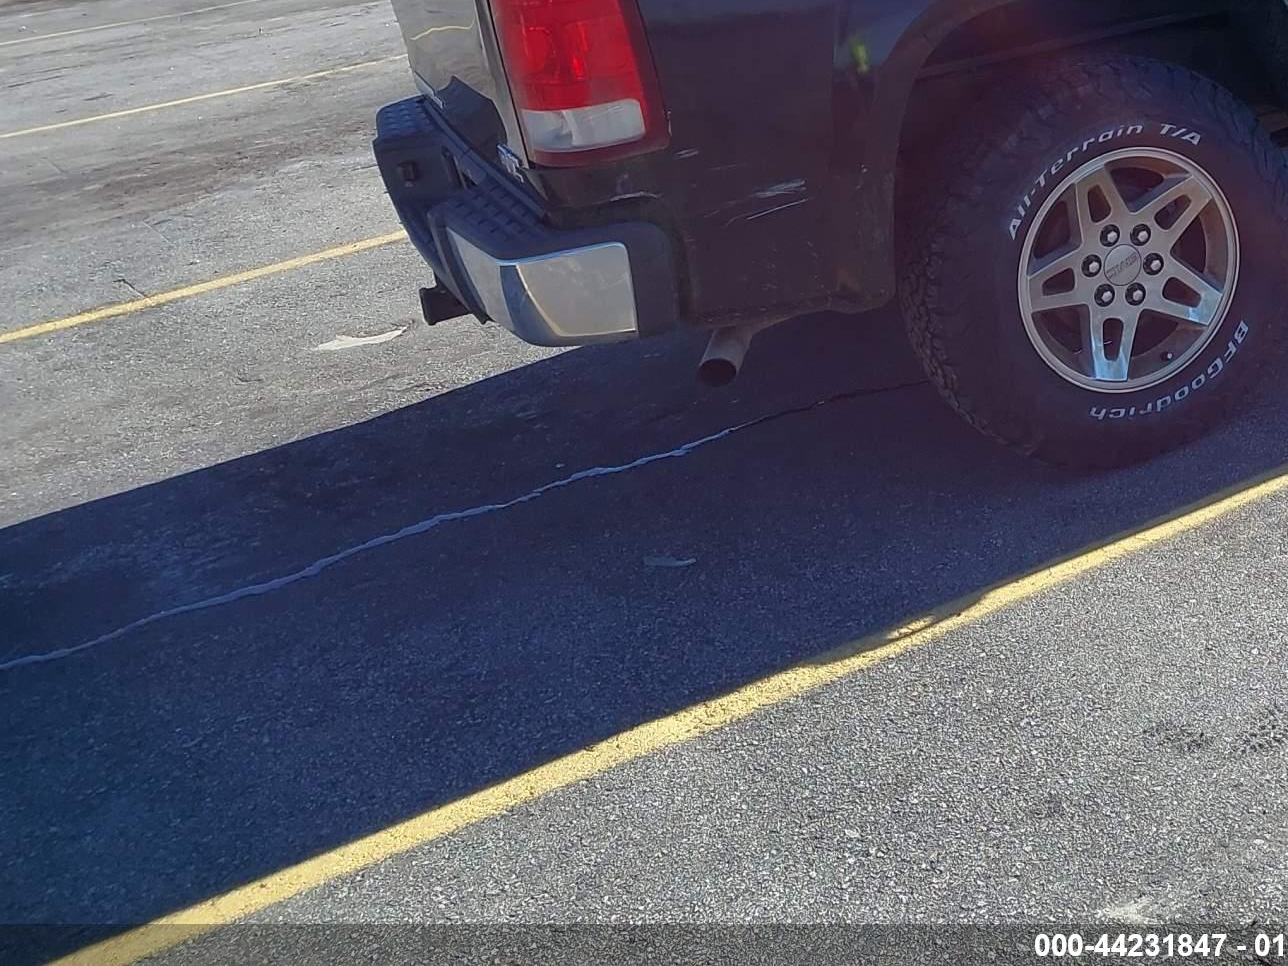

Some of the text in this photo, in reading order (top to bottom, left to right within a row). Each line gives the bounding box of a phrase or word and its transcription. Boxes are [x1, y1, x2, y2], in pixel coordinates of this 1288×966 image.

[1007, 122, 1202, 241] All-Terrain T/A
[1089, 320, 1249, 421] BFGoodrich
